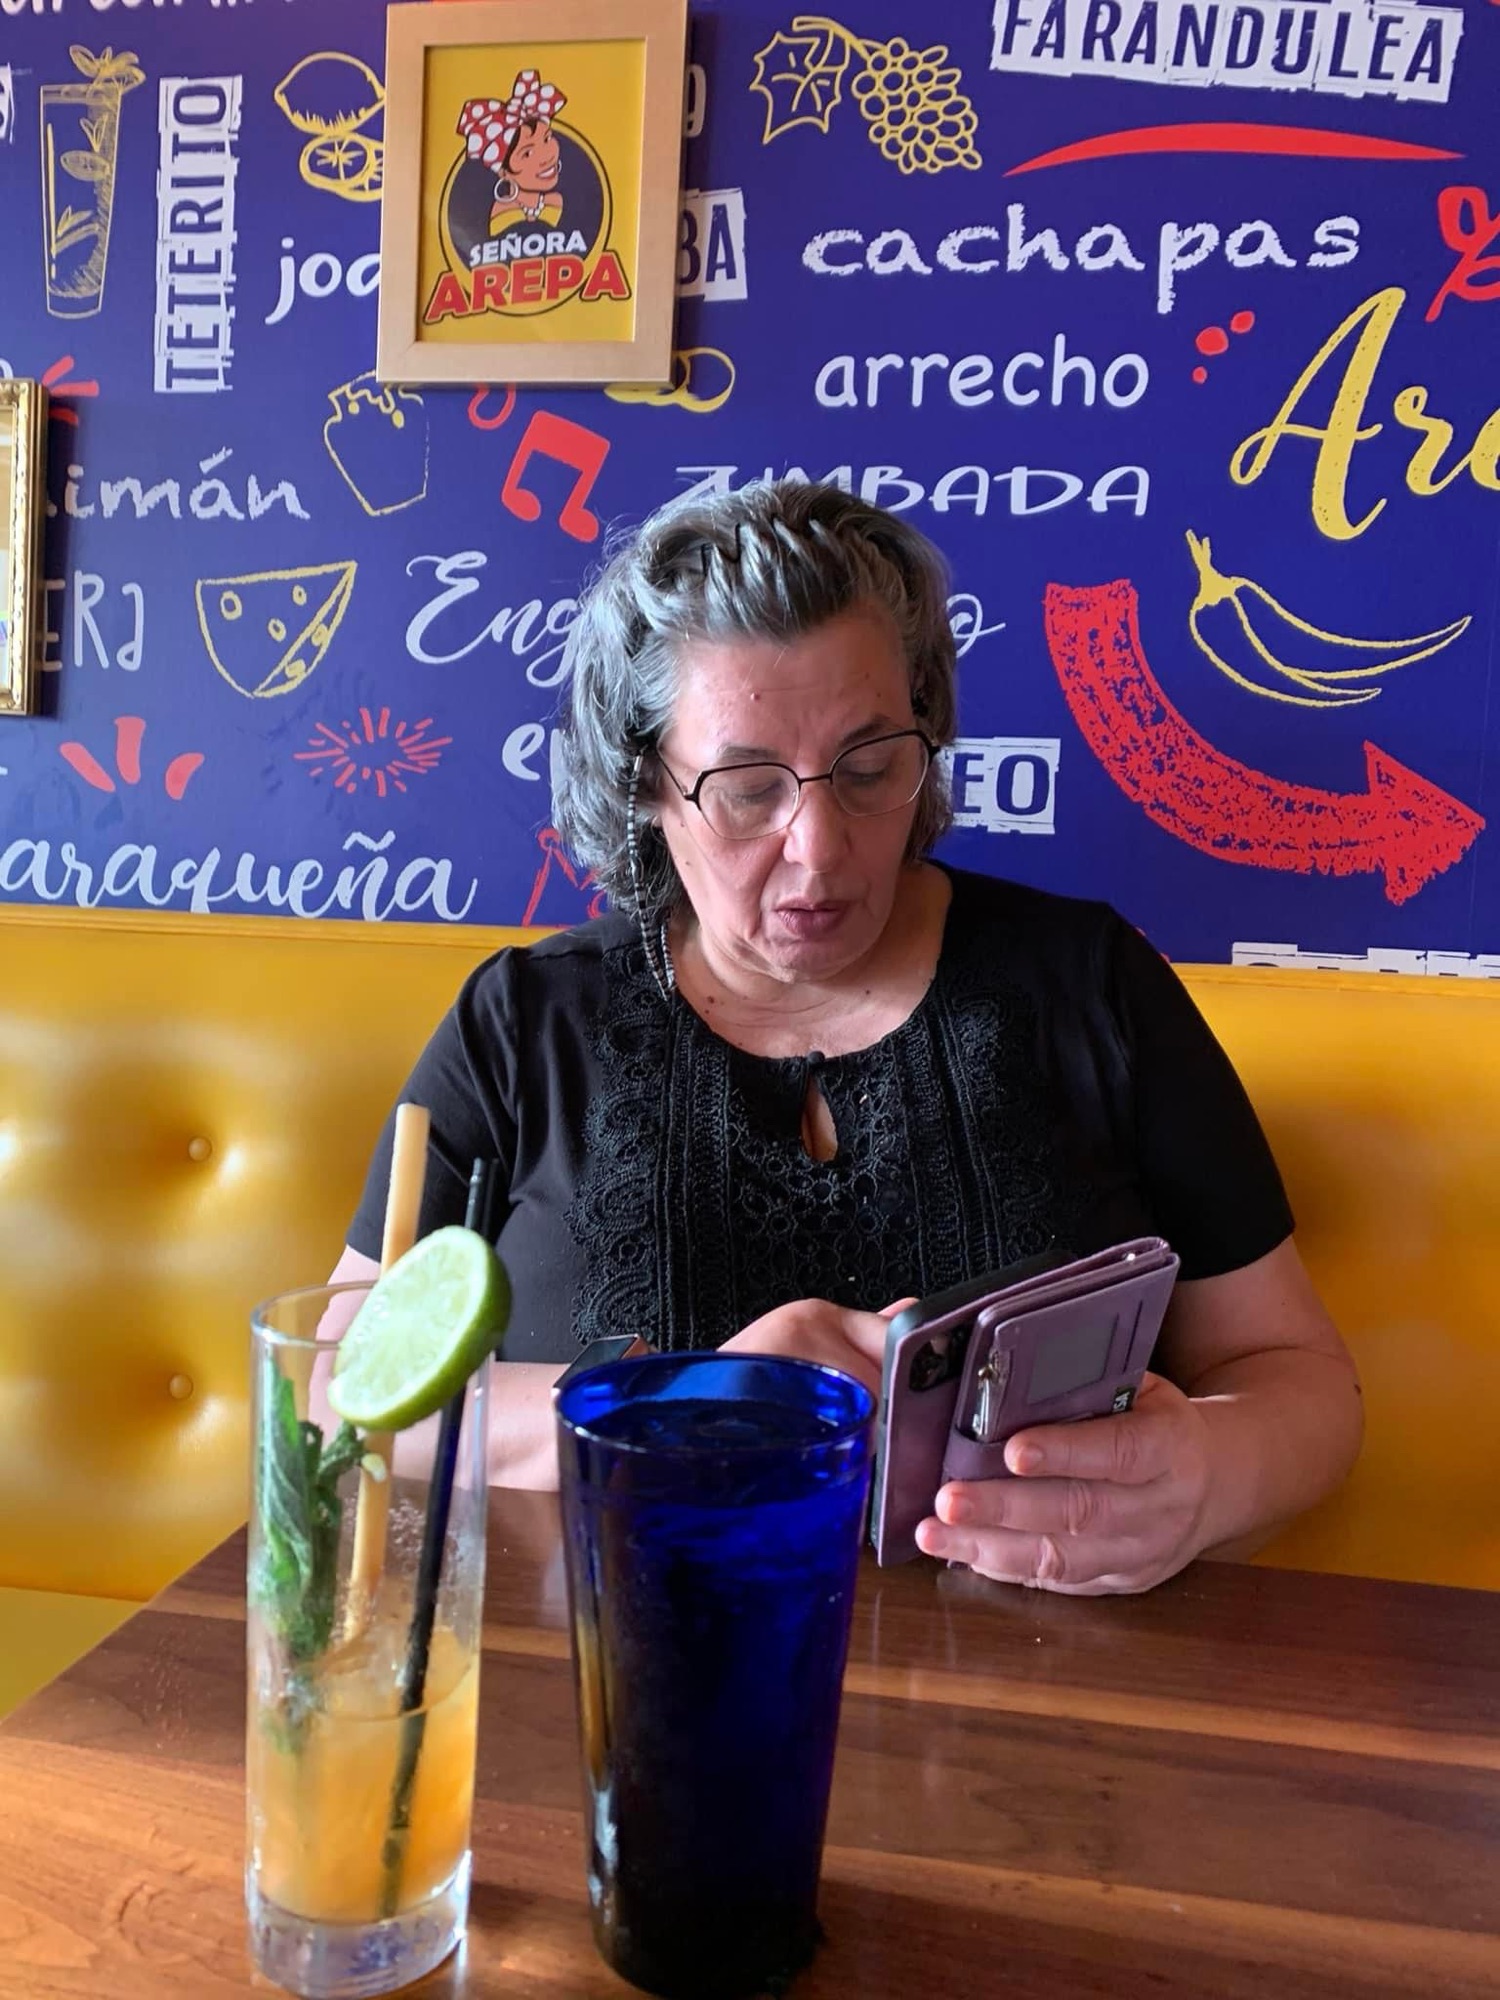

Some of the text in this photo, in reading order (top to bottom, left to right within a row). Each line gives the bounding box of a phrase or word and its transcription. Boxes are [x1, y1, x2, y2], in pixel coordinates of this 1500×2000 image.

[999, 0, 1444, 85] FARANDULEA
[165, 82, 228, 384] TETERITO
[469, 230, 587, 267] SEÑORA
[802, 203, 1361, 314] cachapas
[424, 251, 631, 324] AREPA
[814, 334, 1149, 407] arrecho
[47, 446, 311, 520] imán
[658, 465, 1150, 516] ZBADA
